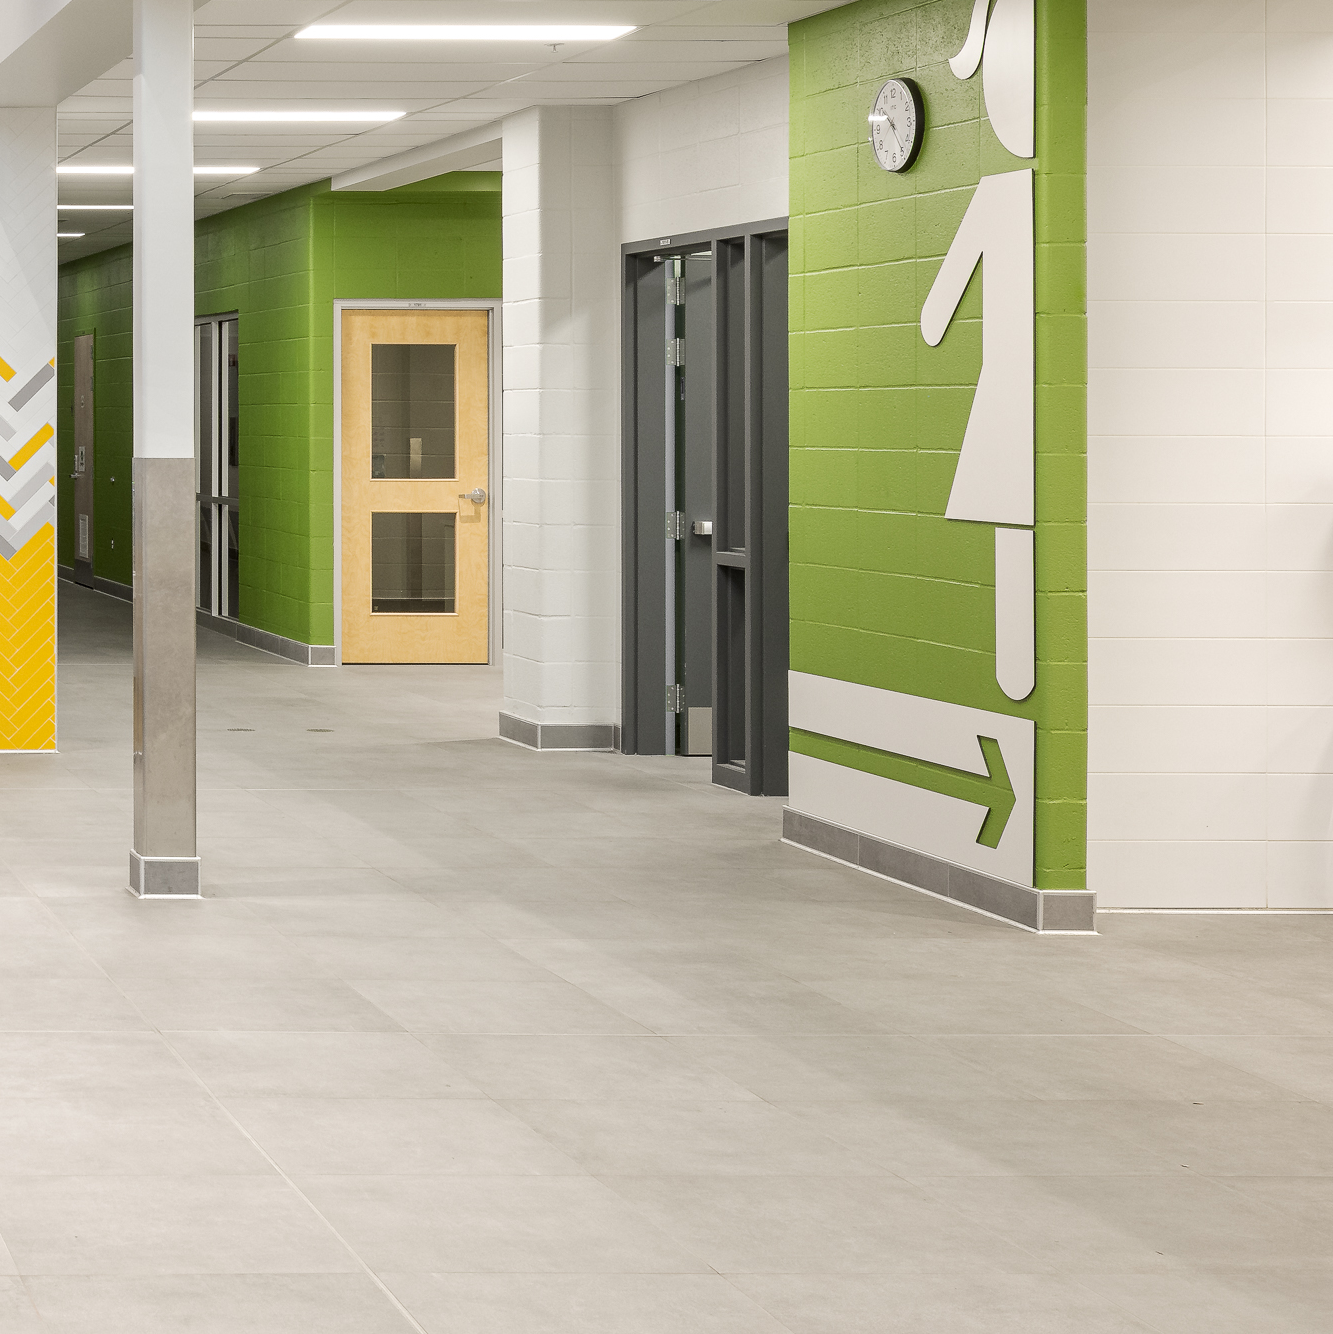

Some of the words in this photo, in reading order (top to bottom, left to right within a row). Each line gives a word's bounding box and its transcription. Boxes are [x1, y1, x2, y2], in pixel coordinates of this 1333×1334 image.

[890, 88, 896, 99] 12
[883, 95, 888, 104] 11
[904, 102, 909, 112] 2
[906, 117, 912, 128] 3
[876, 124, 881, 135] 9
[905, 134, 910, 143] 4
[878, 140, 884, 150] 8
[884, 150, 889, 160] 7
[900, 147, 905, 157] 5
[892, 152, 897, 163] 6
